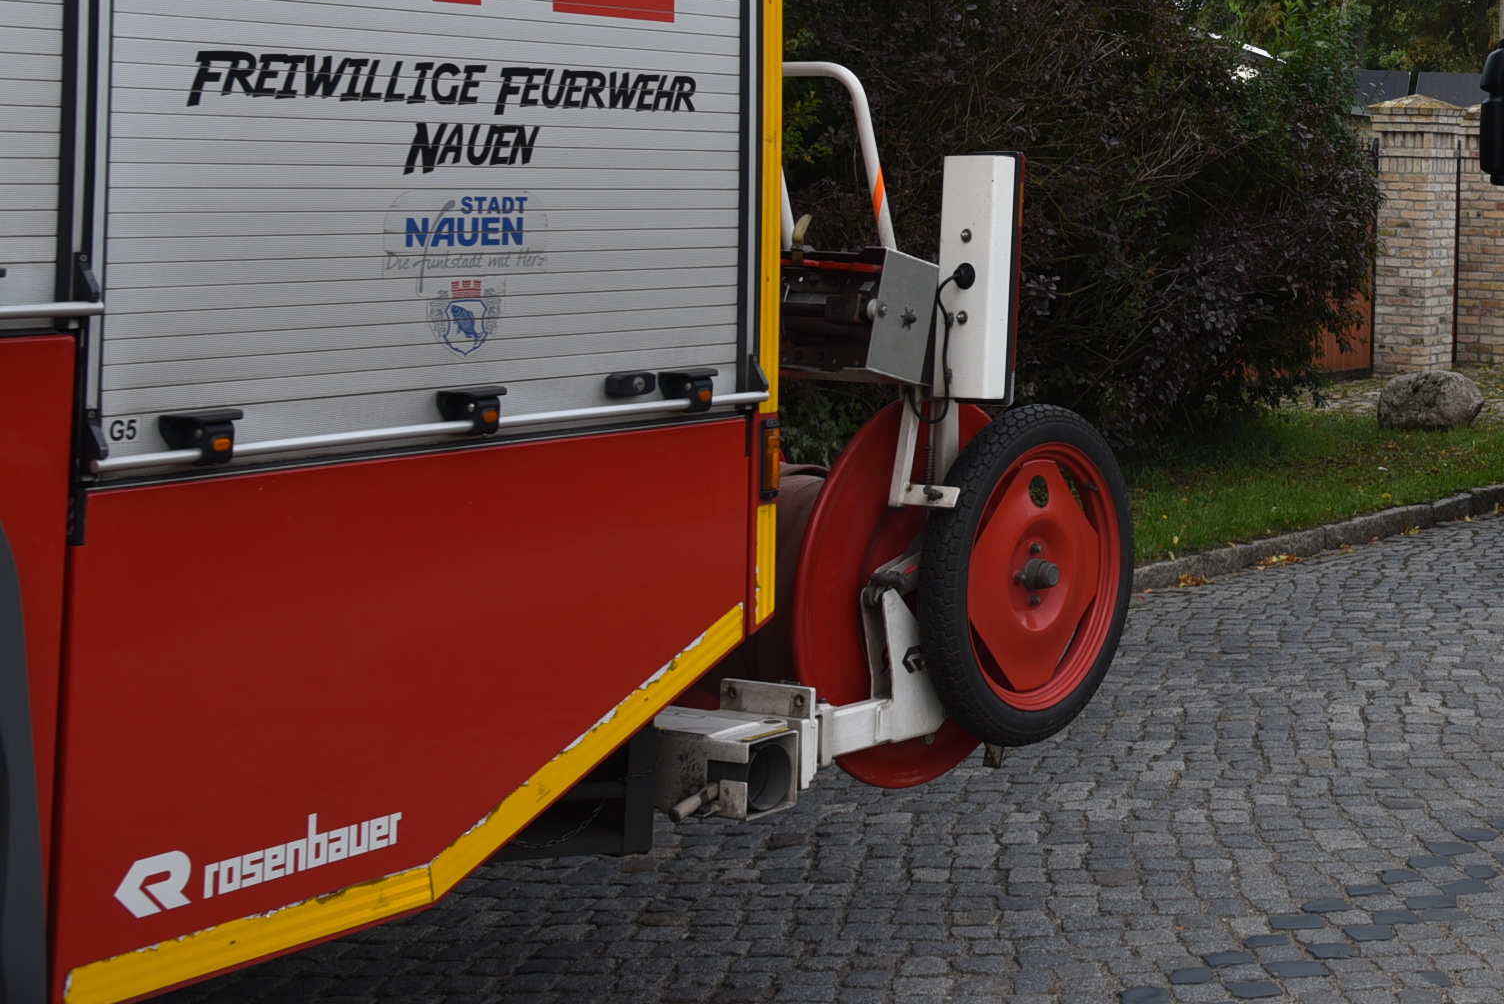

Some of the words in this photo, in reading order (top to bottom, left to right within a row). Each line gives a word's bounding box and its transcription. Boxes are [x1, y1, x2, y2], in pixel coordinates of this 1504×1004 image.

[187, 50, 487, 107] FREIWILLIGE
[494, 67, 697, 115] FEUERWEHR
[402, 122, 541, 176] NAUEN
[460, 196, 528, 214] STADT
[405, 217, 524, 247] NAUEN
[386, 253, 408, 271] Die
[487, 252, 511, 268] mit
[516, 248, 547, 267] Herz
[109, 417, 138, 442] G5
[203, 811, 403, 900] rosenbauer
